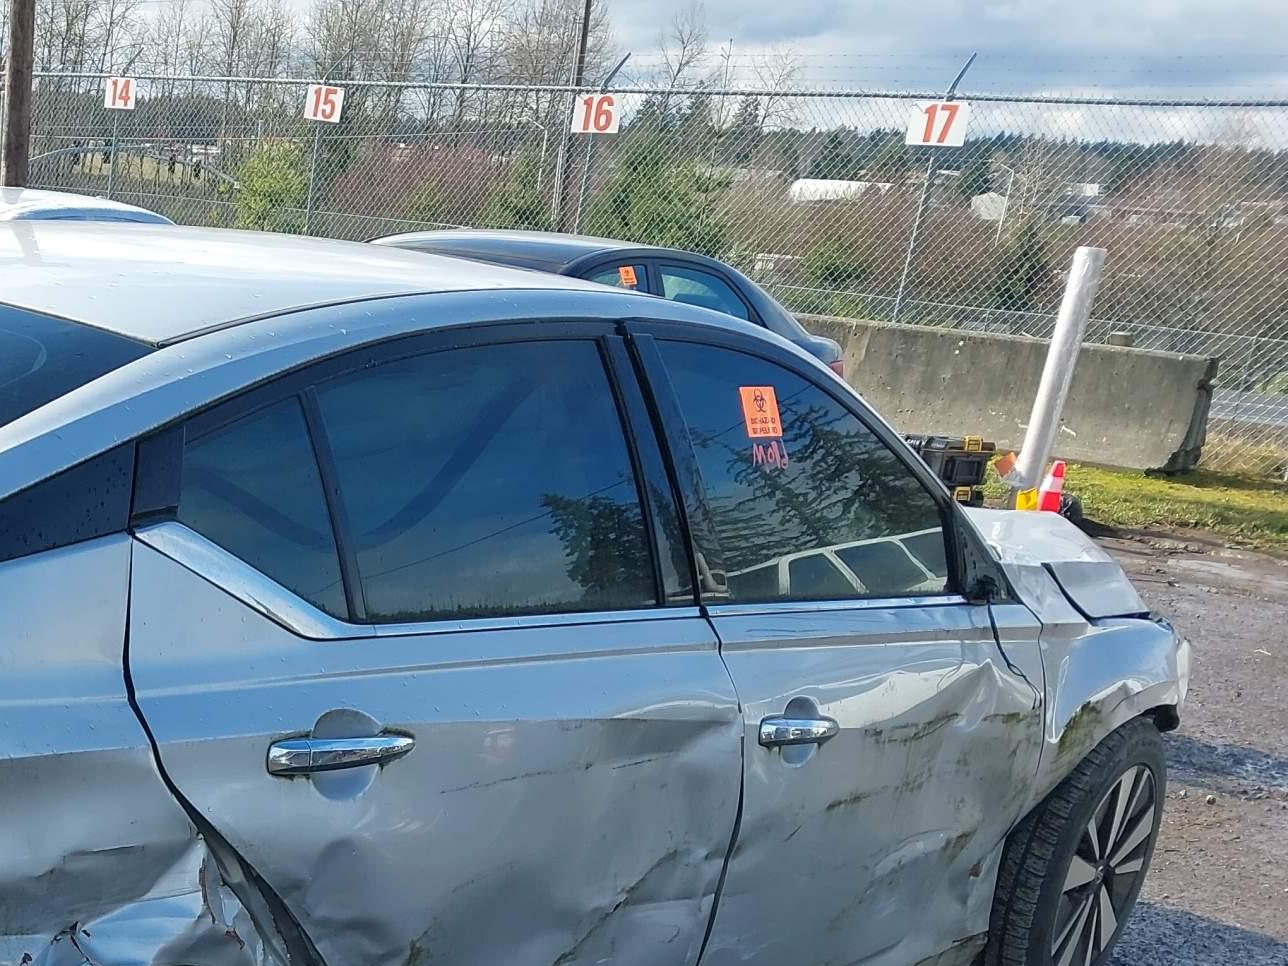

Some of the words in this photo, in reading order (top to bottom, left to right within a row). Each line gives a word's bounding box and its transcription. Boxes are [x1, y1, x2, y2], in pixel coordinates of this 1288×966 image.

[111, 79, 131, 107] 14
[312, 86, 338, 120] 15
[582, 95, 615, 132] 16
[922, 103, 961, 143] 17
